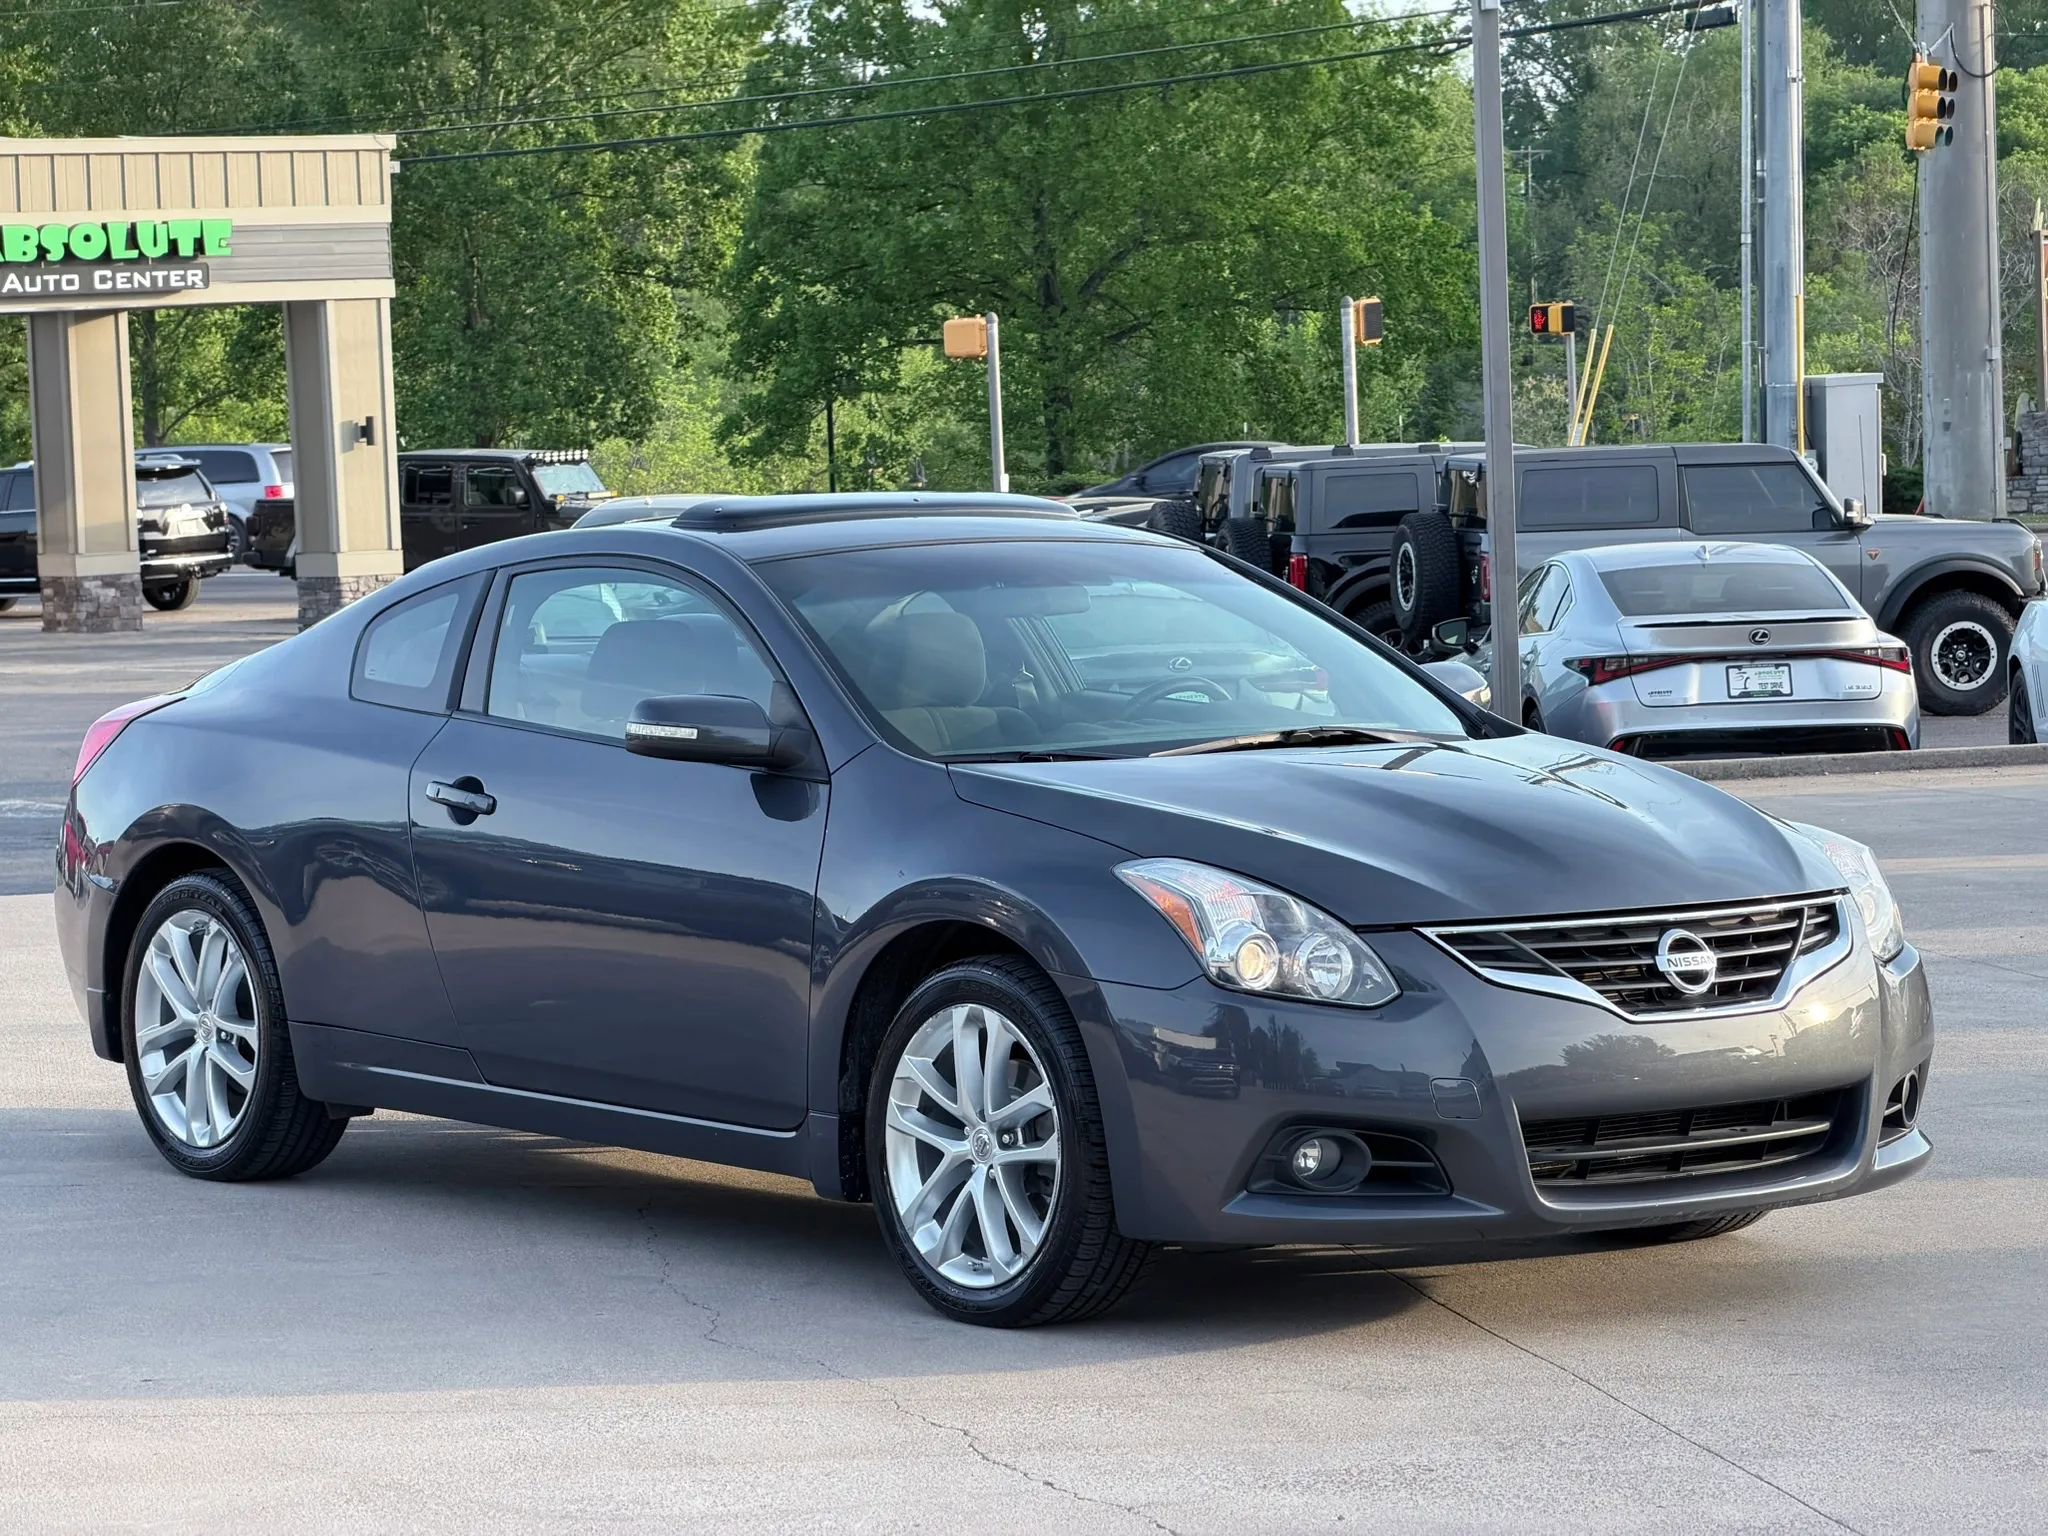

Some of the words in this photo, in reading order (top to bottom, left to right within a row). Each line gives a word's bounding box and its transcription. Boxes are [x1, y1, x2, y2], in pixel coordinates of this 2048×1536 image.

[0, 219, 233, 263] BSOLUTE
[2, 273, 80, 294] AUTO
[94, 269, 205, 290] CENTER
[1667, 955, 1715, 968] NISSAN
